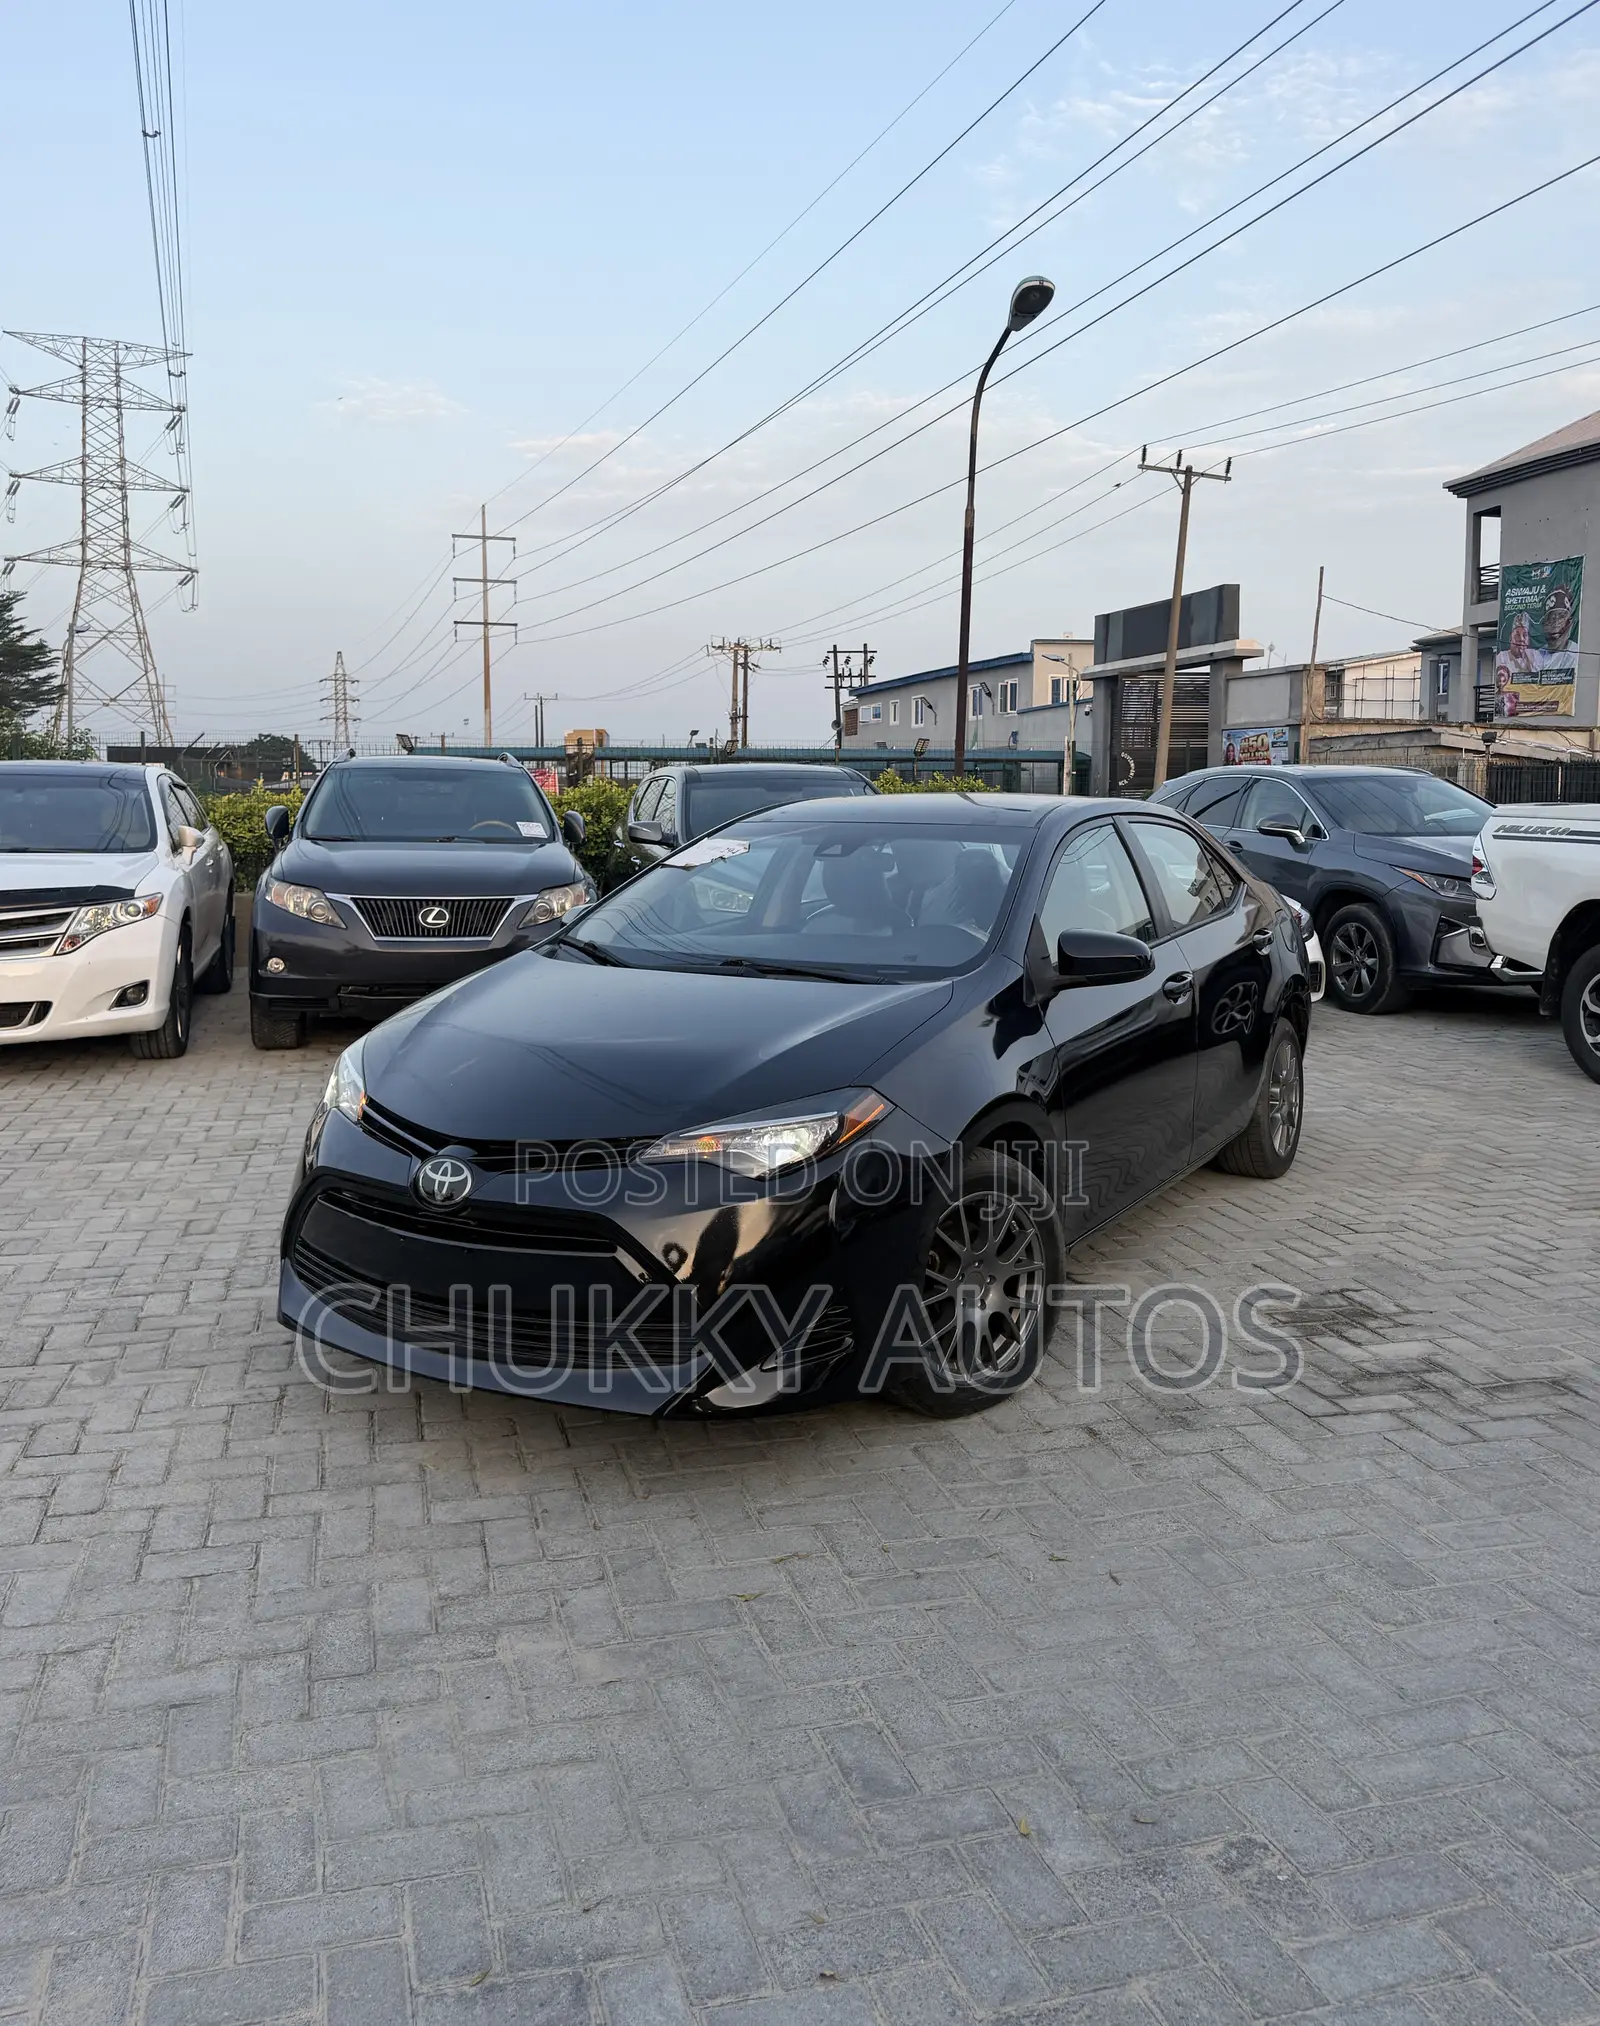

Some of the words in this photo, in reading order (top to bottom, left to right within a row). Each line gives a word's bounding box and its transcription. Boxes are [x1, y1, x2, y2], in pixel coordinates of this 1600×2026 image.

[1540, 584, 1547, 593] &
[1505, 595, 1538, 605] SHETTIMA
[1240, 751, 1269, 760] MILLION
